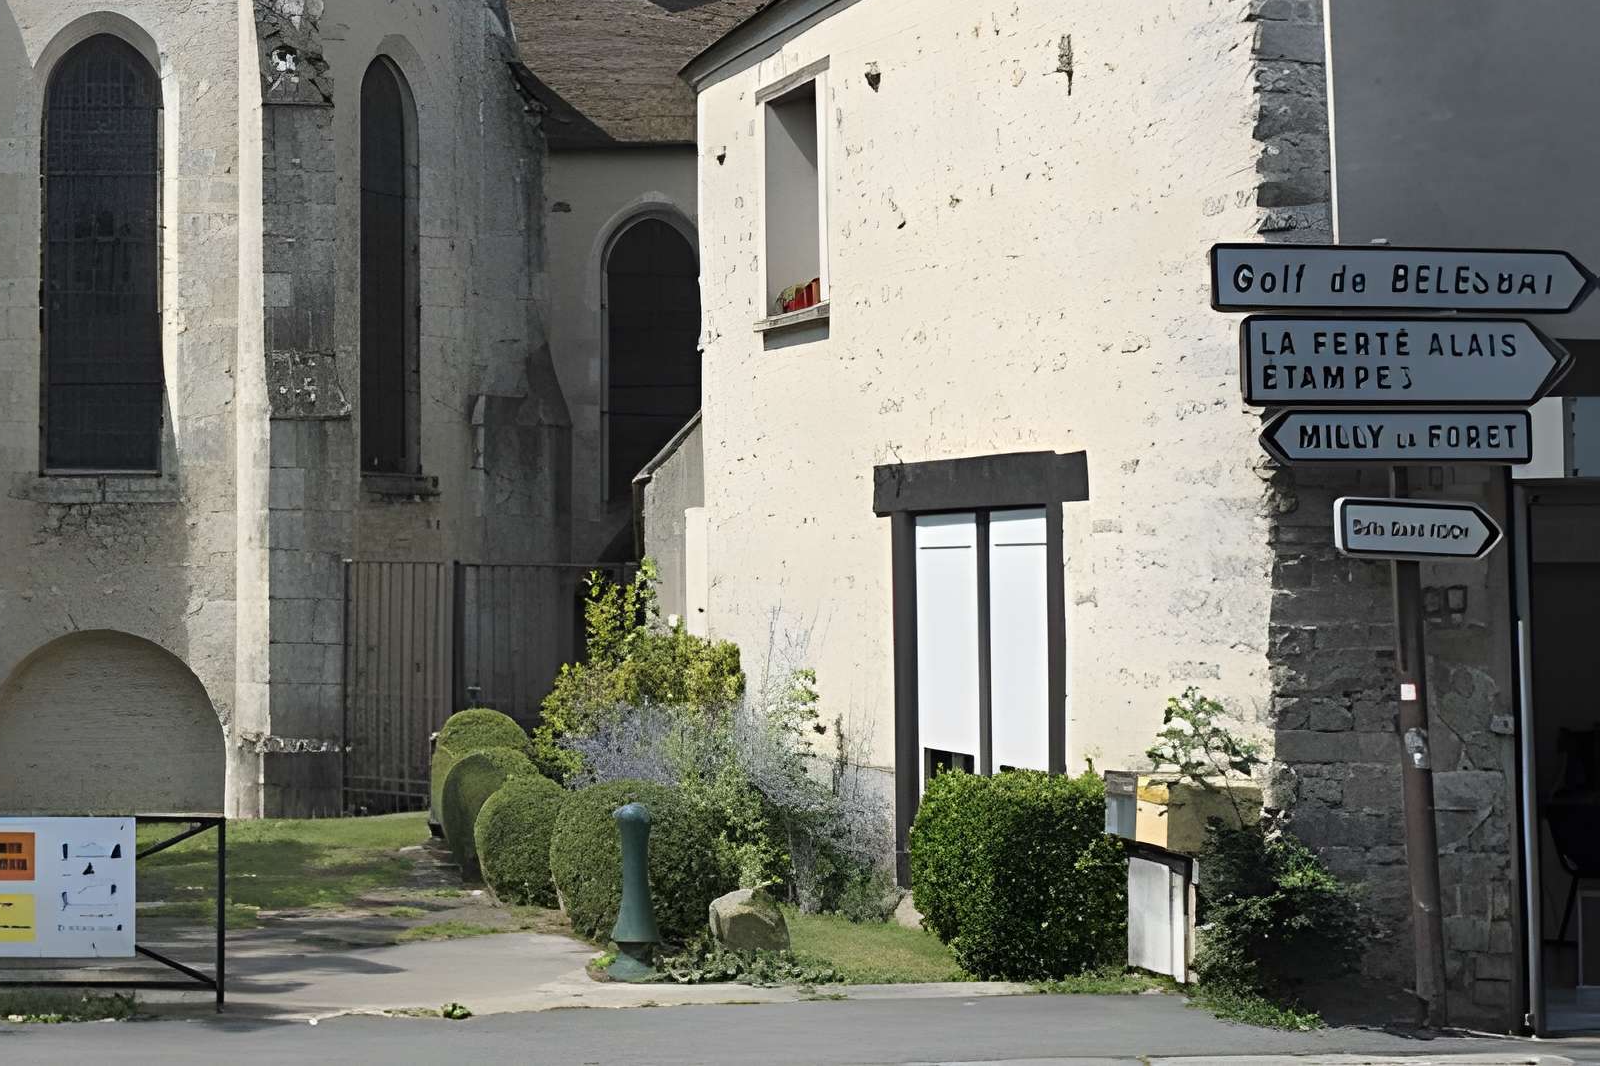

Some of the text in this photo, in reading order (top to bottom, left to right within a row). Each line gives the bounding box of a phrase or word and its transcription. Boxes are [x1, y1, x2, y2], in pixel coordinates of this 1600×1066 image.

[1232, 263, 1307, 294] Golf
[1330, 264, 1367, 294] de
[1261, 328, 1518, 358] LA FERTÉ ALAIS
[1299, 424, 1385, 450] MILLY
